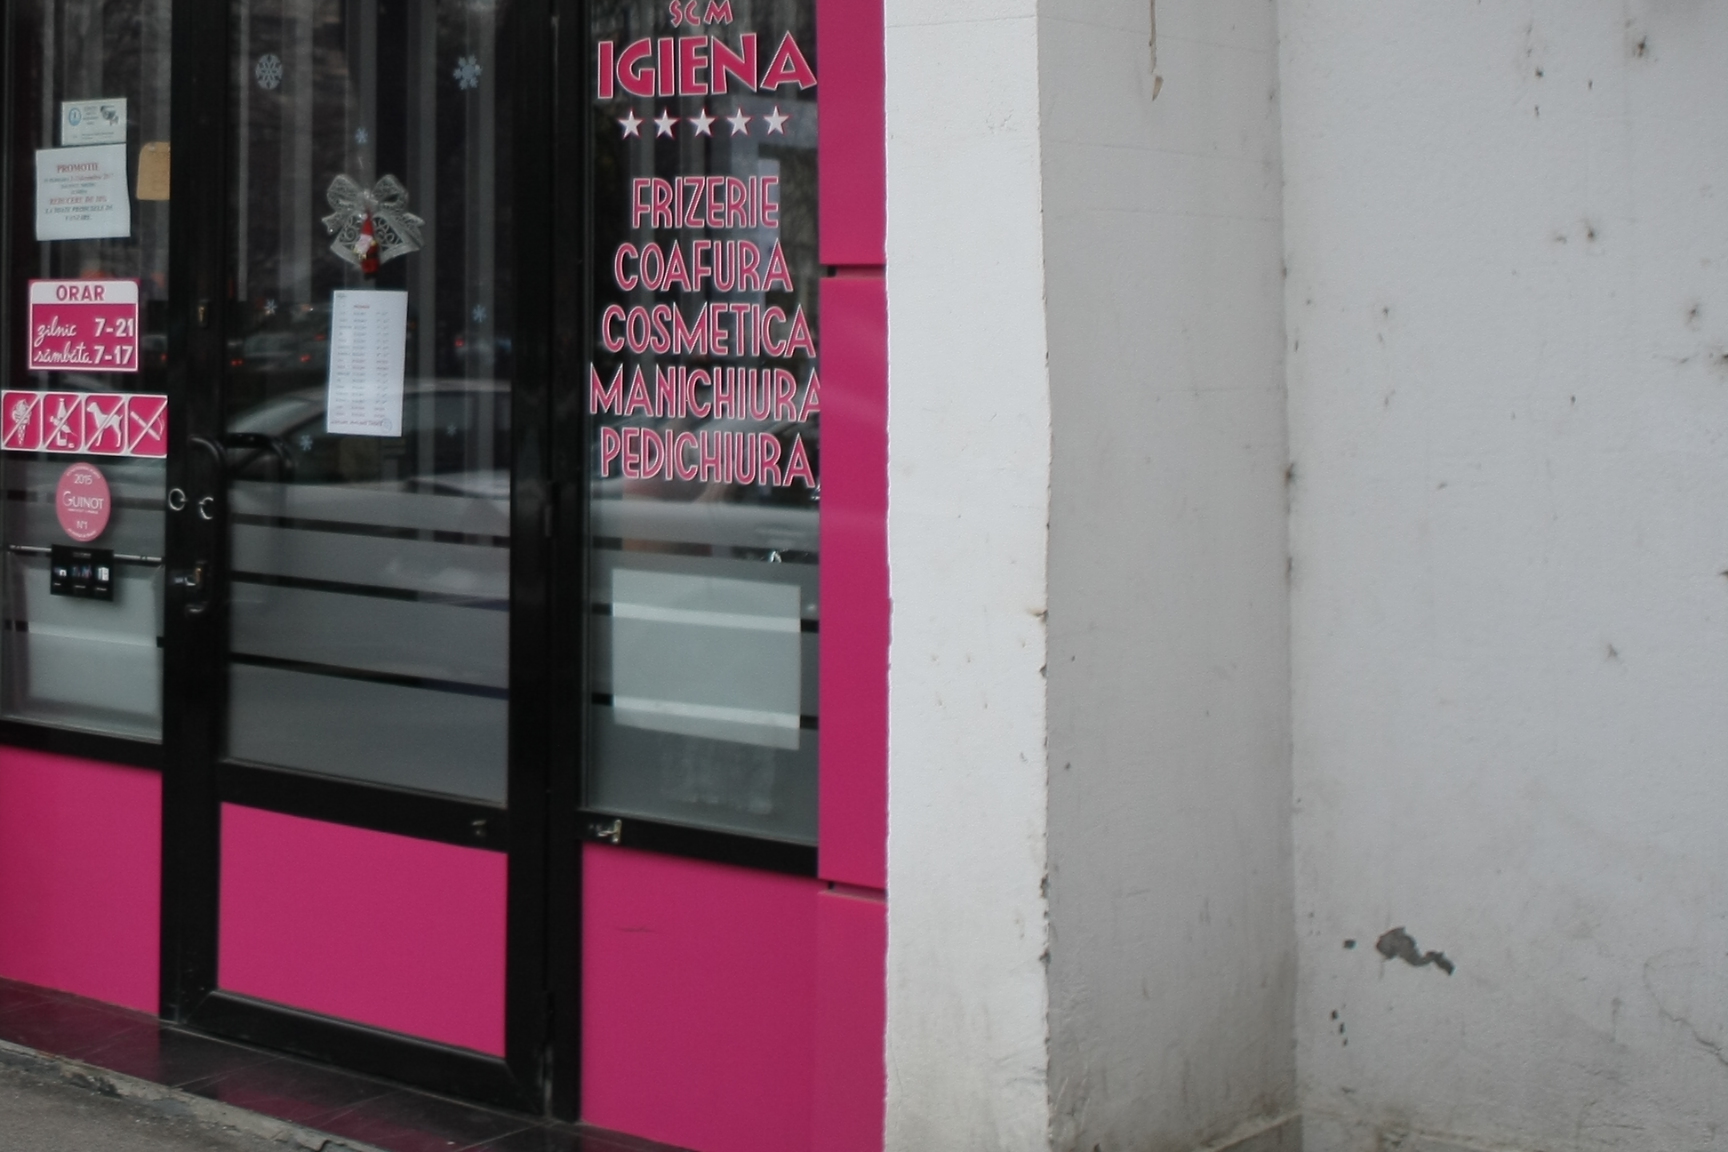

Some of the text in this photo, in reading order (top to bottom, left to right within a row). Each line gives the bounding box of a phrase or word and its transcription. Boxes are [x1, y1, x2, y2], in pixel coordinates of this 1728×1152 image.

[597, 30, 818, 99] IGIENA
[632, 176, 779, 229] FRIZERIE
[614, 238, 794, 292] COAFURA
[56, 285, 105, 301] ORAR
[34, 315, 135, 347] zilnic 7-21
[94, 345, 134, 365] 7-17
[602, 301, 817, 358] COSMETICA
[590, 362, 820, 423] MANICHIURA
[601, 427, 816, 488] PEDICHIURA
